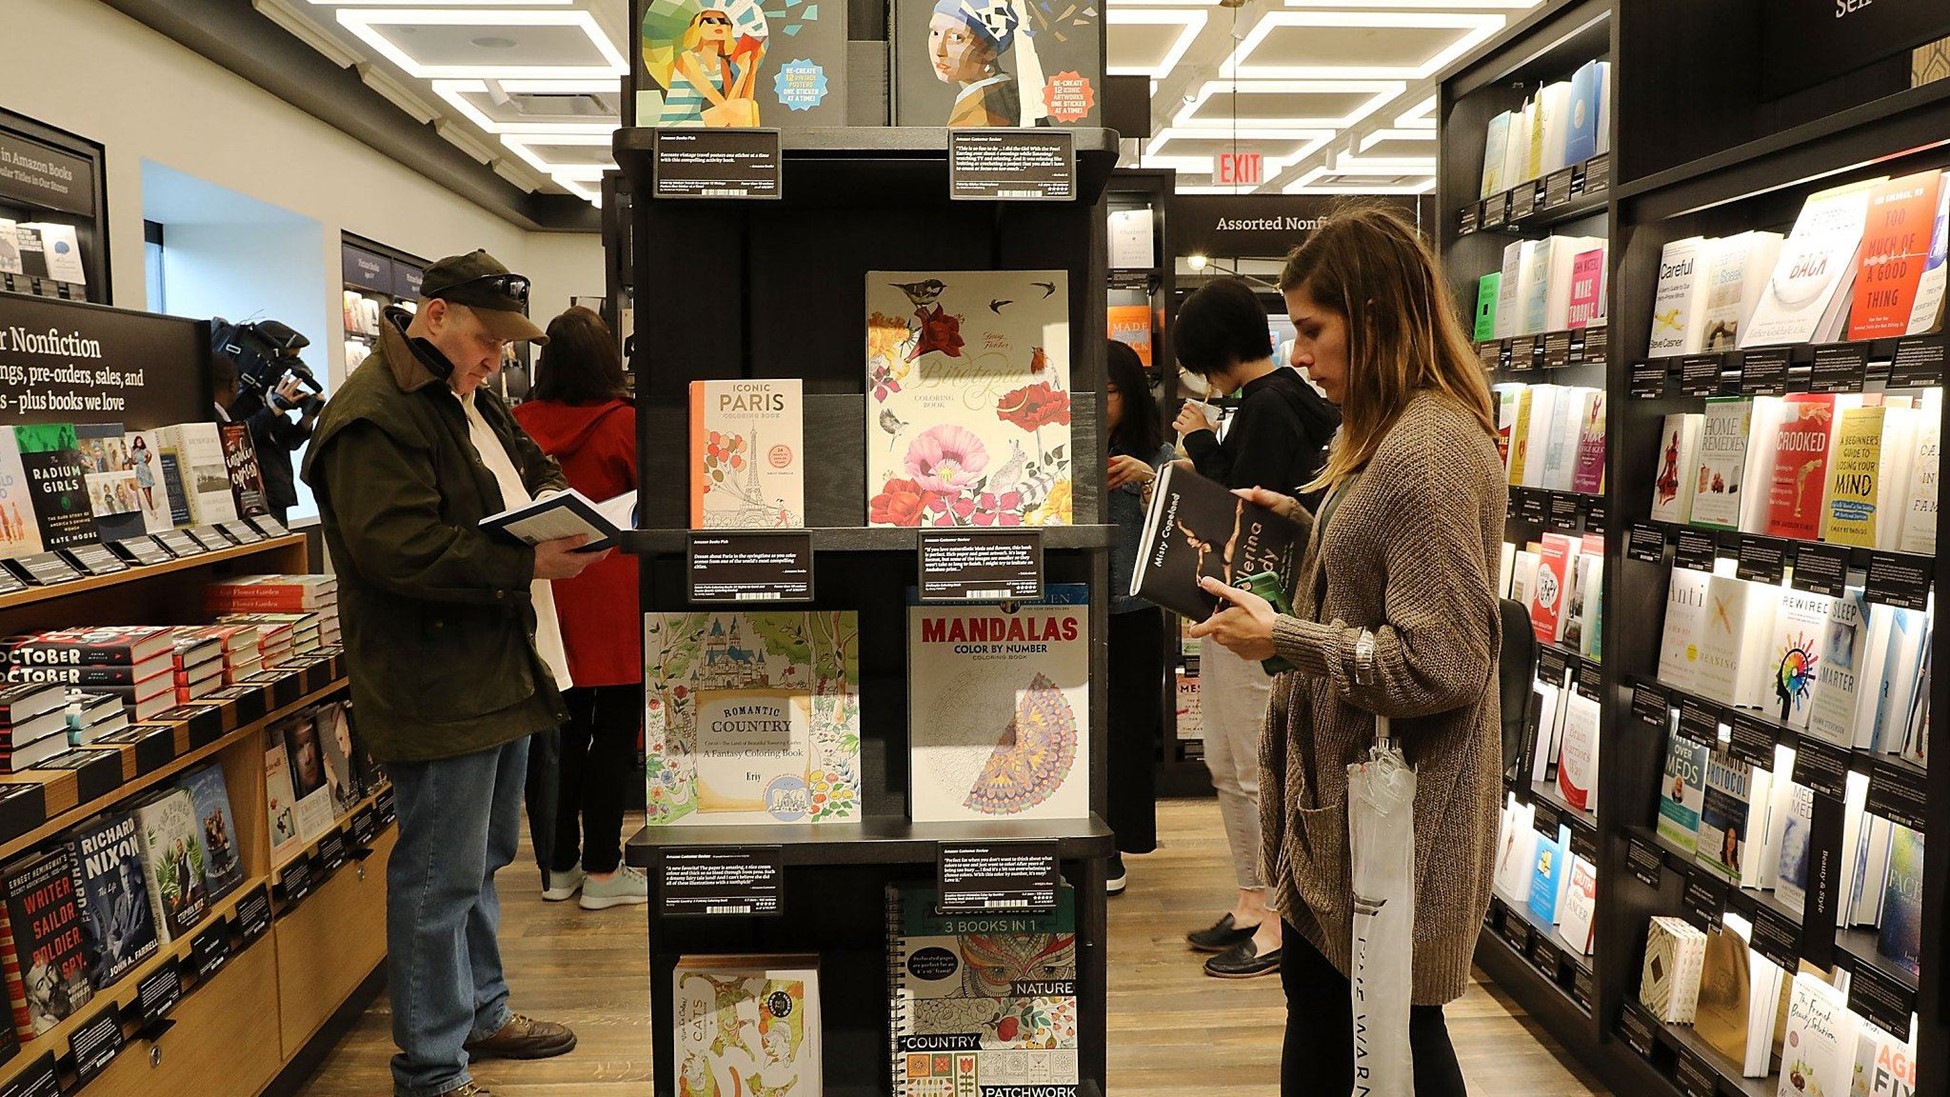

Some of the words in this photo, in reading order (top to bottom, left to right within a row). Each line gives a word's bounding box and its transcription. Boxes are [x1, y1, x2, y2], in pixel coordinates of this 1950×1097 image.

[13, 152, 48, 174] Amazon
[49, 162, 73, 181] Books
[1220, 153, 1261, 184] EXIT
[1216, 217, 1282, 231] Assorted
[1285, 217, 1327, 231] Nonfi
[1885, 208, 1906, 227] TOO
[1868, 237, 1896, 255] MUCH
[1901, 233, 1916, 251] OF
[1661, 258, 1694, 280] Careful
[1866, 270, 1873, 283] A
[1877, 262, 1907, 281] GOOD
[1574, 279, 1593, 299] MAKE
[1867, 289, 1899, 309] THING
[1569, 302, 1595, 324] TROUBLE
[1113, 323, 1148, 332] MADE
[9, 326, 102, 359] Nonfiction
[28, 364, 95, 388] pre-orders,
[95, 366, 124, 389] sales,
[124, 368, 145, 387] and
[733, 384, 770, 392] ICONIC
[18, 389, 47, 414] plus
[49, 391, 84, 411] books
[85, 396, 101, 411] we
[102, 392, 125, 411] love
[720, 394, 784, 411] PARIS
[1704, 418, 1739, 435] HOME
[1701, 436, 1745, 452] REMEDIES
[1777, 431, 1826, 452] CROOKED
[1844, 449, 1861, 458] GUIDE
[1862, 448, 1870, 458] TO
[32, 465, 81, 480] RADIUM
[1836, 461, 1856, 471] LOSING
[1857, 461, 1876, 472] YOUR
[43, 480, 79, 493] GIRLS
[1834, 474, 1873, 497] MIND
[1922, 472, 1935, 484] IN
[1161, 493, 1181, 539] Copeland
[50, 536, 70, 544] KATE
[72, 531, 97, 540] MOORE
[1154, 541, 1169, 568] Misty
[1236, 522, 1263, 577] lerina
[1258, 548, 1280, 572] dy
[1833, 601, 1857, 622] SLEEP
[922, 617, 1078, 642] MANDALAS
[954, 645, 988, 654] COLOR
[991, 645, 1003, 653] BY
[1006, 645, 1047, 653] NUMBER
[723, 705, 780, 718] ROMANTIC
[711, 721, 792, 733] COUNTRY
[712, 749, 743, 759] Fantasy
[745, 749, 780, 758] Coloring
[782, 749, 804, 757] Book
[1674, 744, 1693, 760] OVER
[1666, 755, 1699, 784] MEDS
[81, 817, 135, 856] RICHARD
[85, 834, 140, 880] NIXON
[1820, 850, 1829, 880] Beauty
[8, 869, 31, 890] ERNEST
[32, 854, 68, 878] HEMINGWAY'S
[24, 876, 74, 915] WRITER.
[98, 883, 107, 897] The
[106, 882, 117, 894] Life
[1818, 890, 1826, 913] Style
[32, 901, 78, 940] SAILOR.
[945, 922, 953, 932] 3
[958, 921, 1007, 932] BOOKS
[1012, 920, 1026, 931] IN
[1030, 920, 1035, 931] 1
[32, 926, 83, 969] SOLDIER.
[110, 960, 127, 978] JOHN
[127, 954, 135, 969] A.
[135, 938, 159, 963] FARRELL
[62, 951, 87, 981] SPY.
[1016, 982, 1074, 994] NATURE
[693, 999, 703, 1042] CATS
[1809, 999, 1833, 1025] French
[906, 1036, 976, 1048] COUNTRY
[986, 1087, 1076, 1097] PATCHWORK
